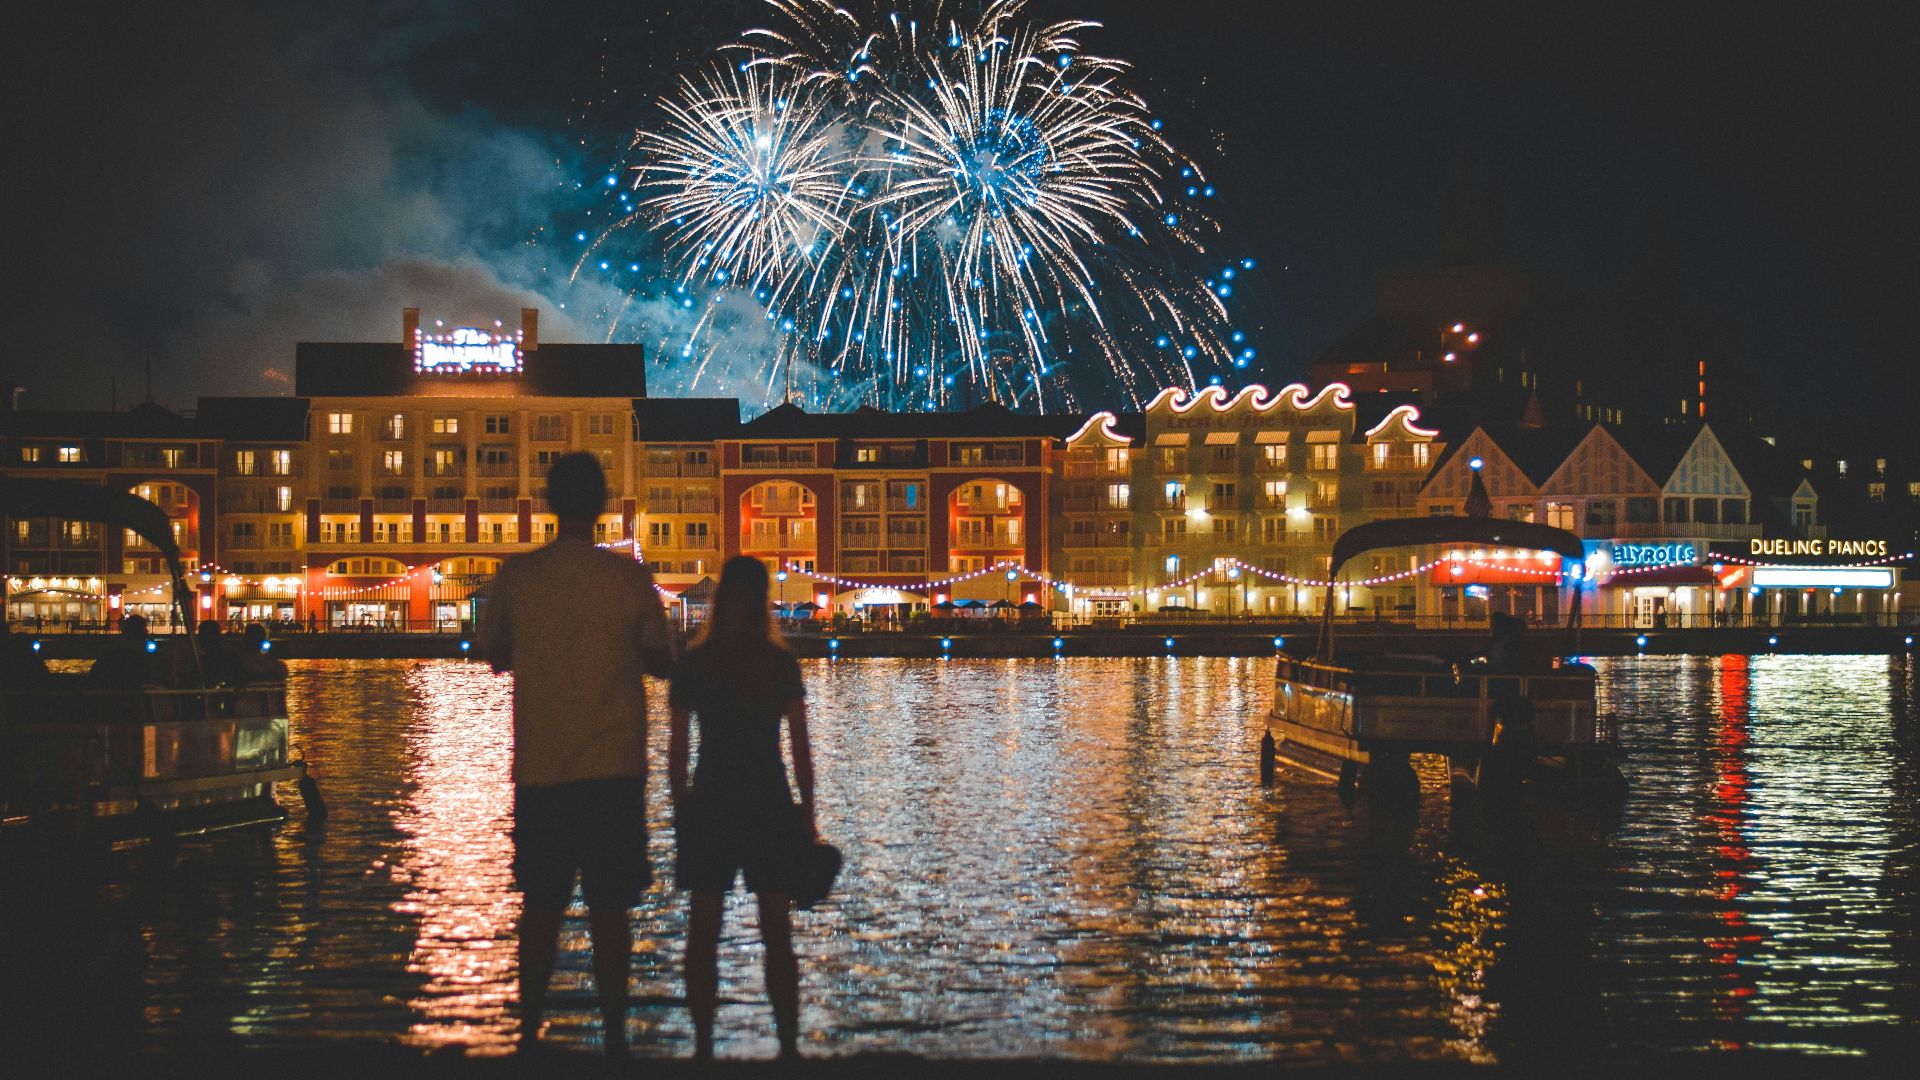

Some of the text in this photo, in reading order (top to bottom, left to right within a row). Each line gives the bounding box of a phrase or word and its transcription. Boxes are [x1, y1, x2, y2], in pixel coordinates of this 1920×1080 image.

[1611, 544, 1696, 564] ELLYROLLS
[1751, 538, 1887, 556] DUELING PIANOS
